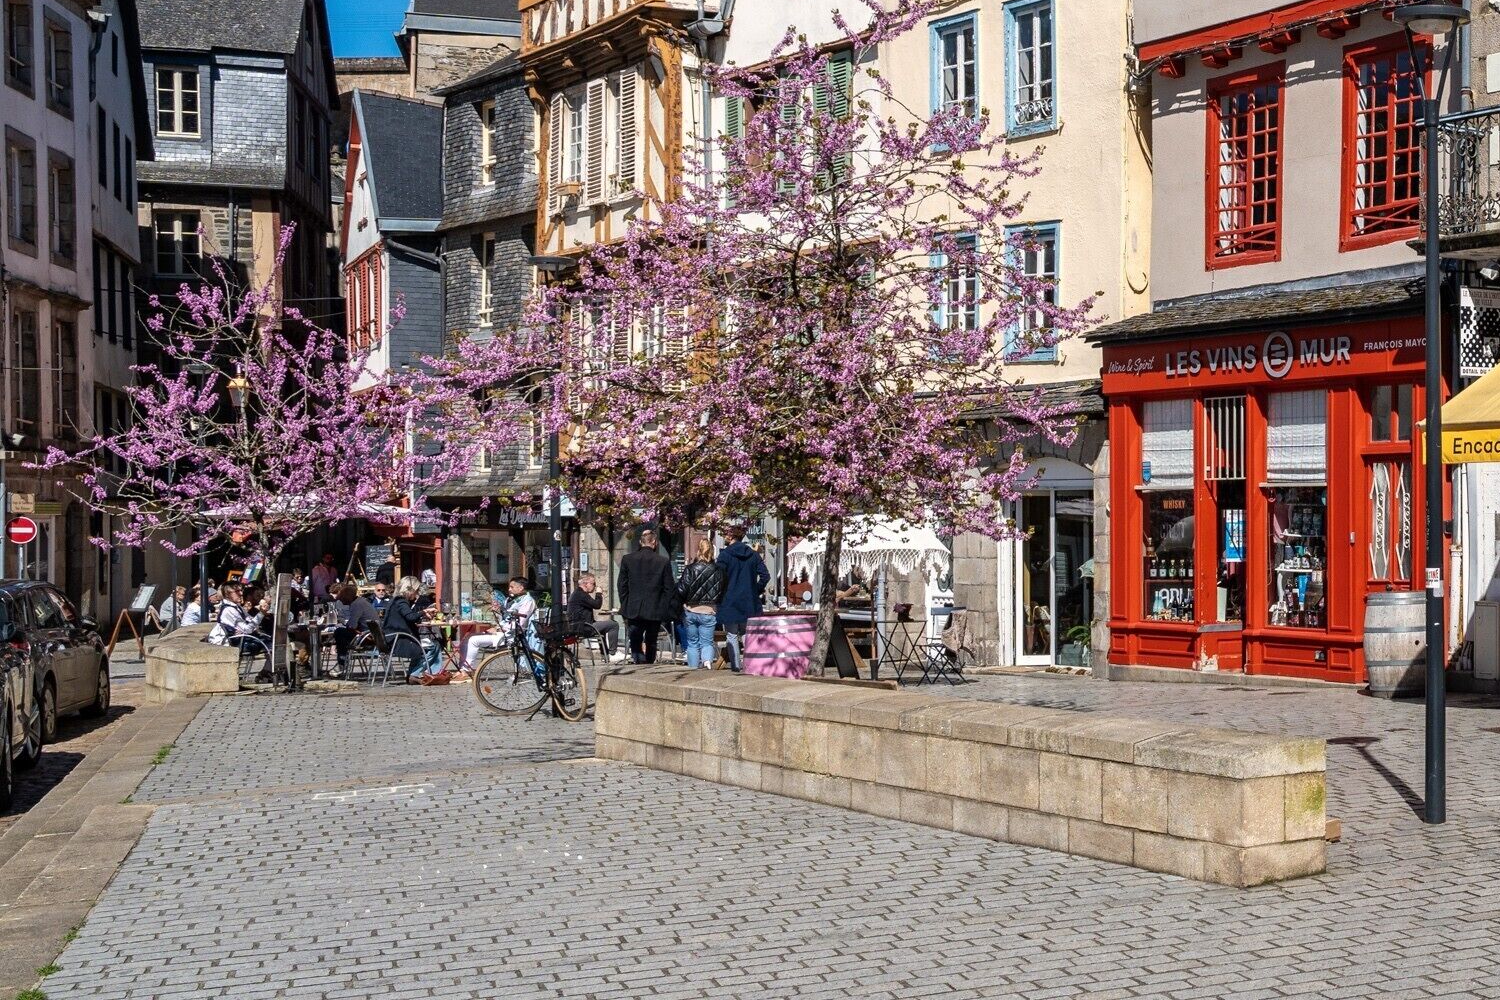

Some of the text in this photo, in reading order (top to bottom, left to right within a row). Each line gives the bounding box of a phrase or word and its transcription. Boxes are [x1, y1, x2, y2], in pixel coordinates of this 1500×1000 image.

[1363, 340, 1403, 351] FRANÇOIS
[1165, 336, 1351, 376] LES VINS MUR
[1108, 356, 1155, 376] Wine & Spirit
[1162, 500, 1185, 510] WHISKY
